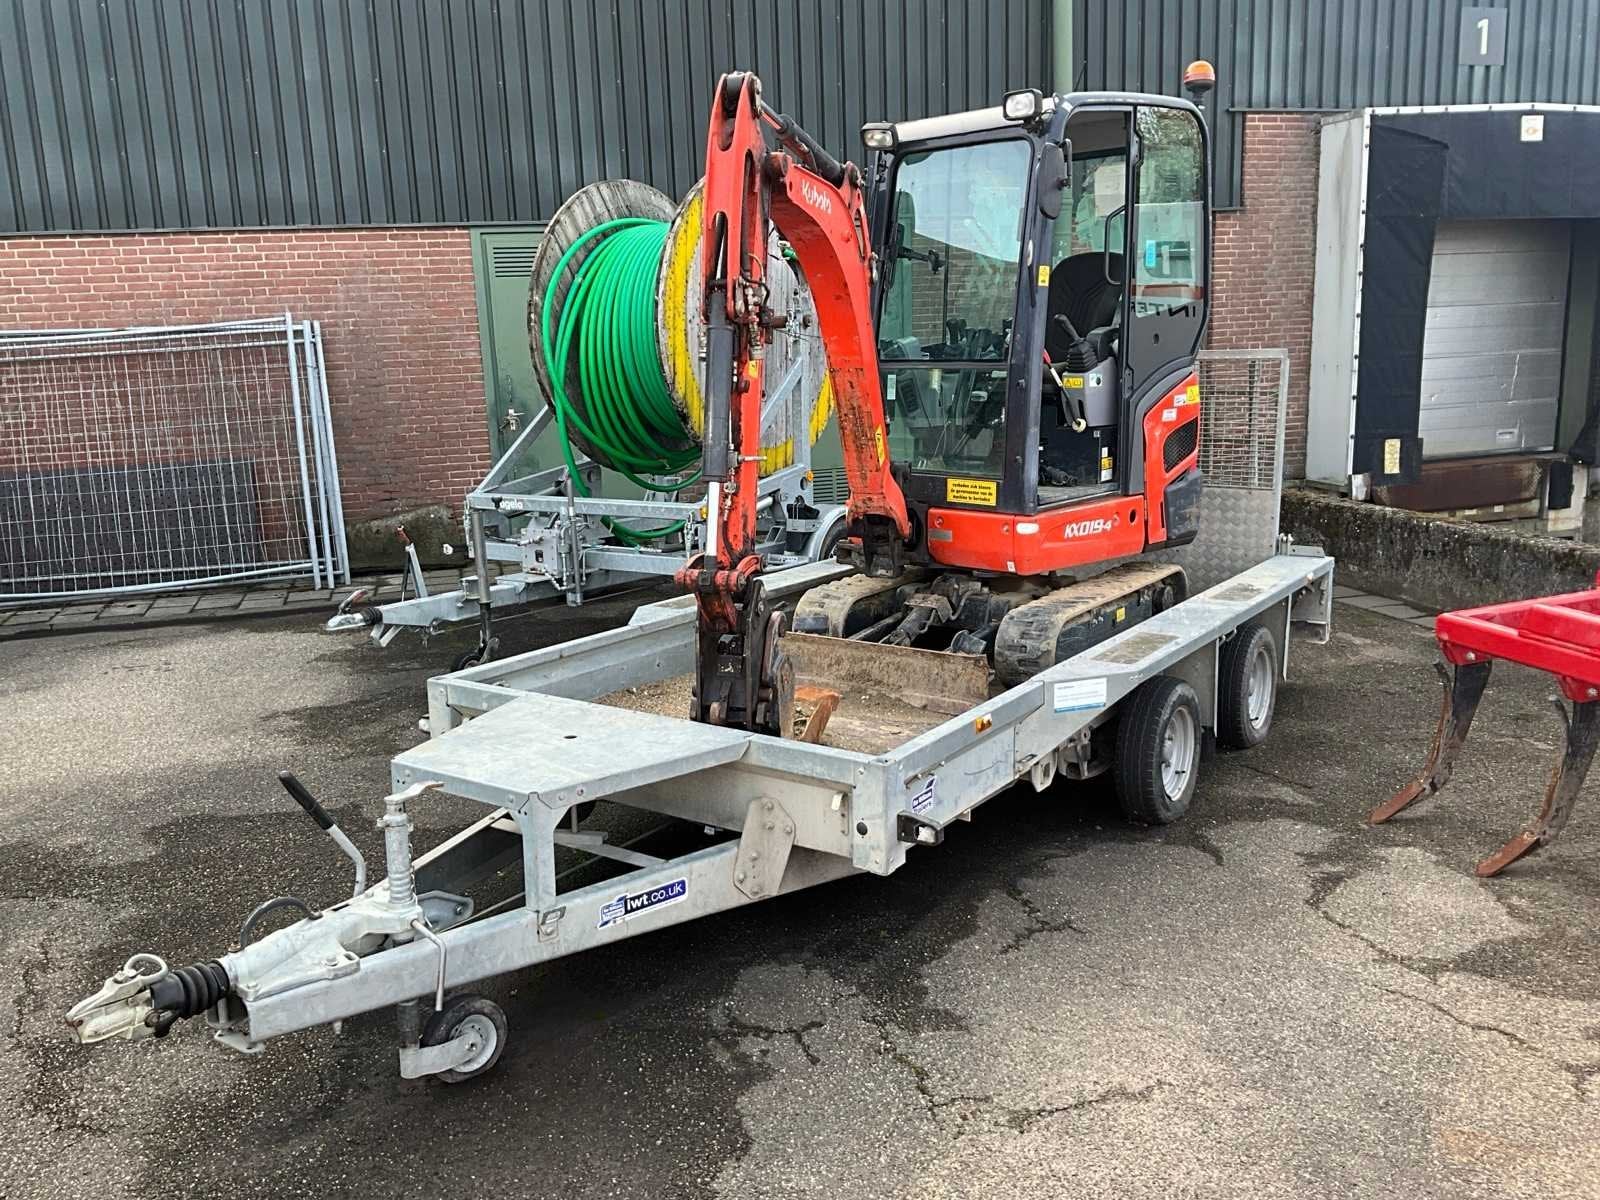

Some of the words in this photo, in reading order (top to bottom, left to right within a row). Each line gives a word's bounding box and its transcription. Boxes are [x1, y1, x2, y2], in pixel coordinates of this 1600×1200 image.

[1477, 18, 1488, 55] 1
[801, 179, 832, 214] Kubota
[494, 497, 523, 511] agela
[1064, 519, 1113, 539] KX019-4
